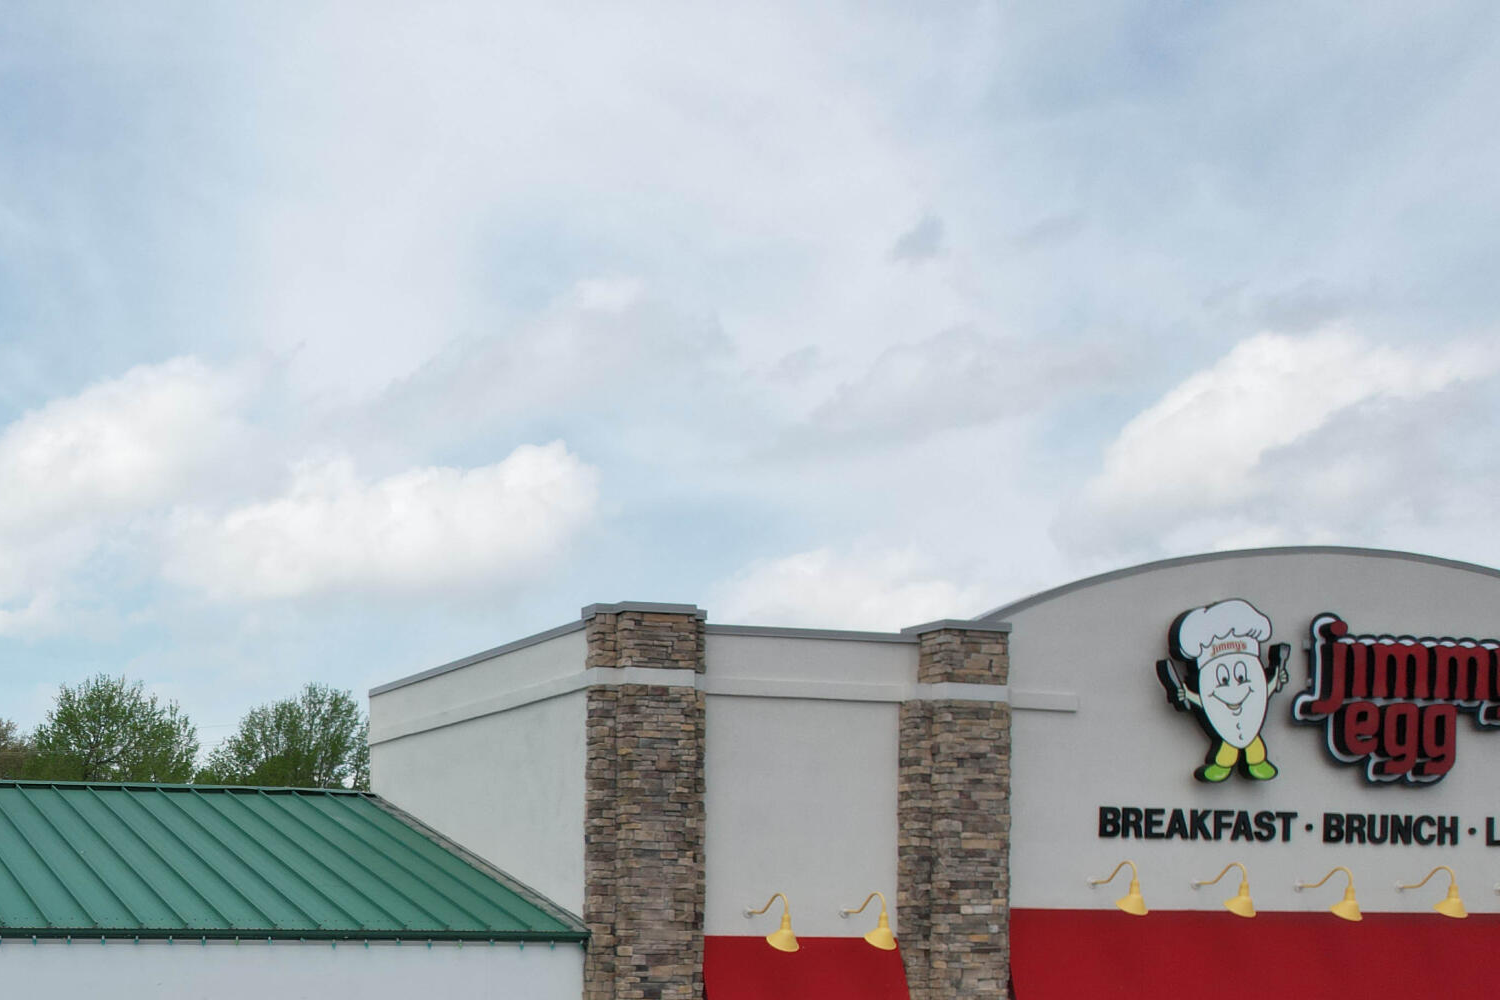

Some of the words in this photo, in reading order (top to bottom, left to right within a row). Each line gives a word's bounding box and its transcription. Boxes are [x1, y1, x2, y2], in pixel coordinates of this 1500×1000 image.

[1343, 700, 1458, 776] egg
[1098, 806, 1298, 843] BREAKFAST
[1322, 812, 1460, 846] BRUNCH
